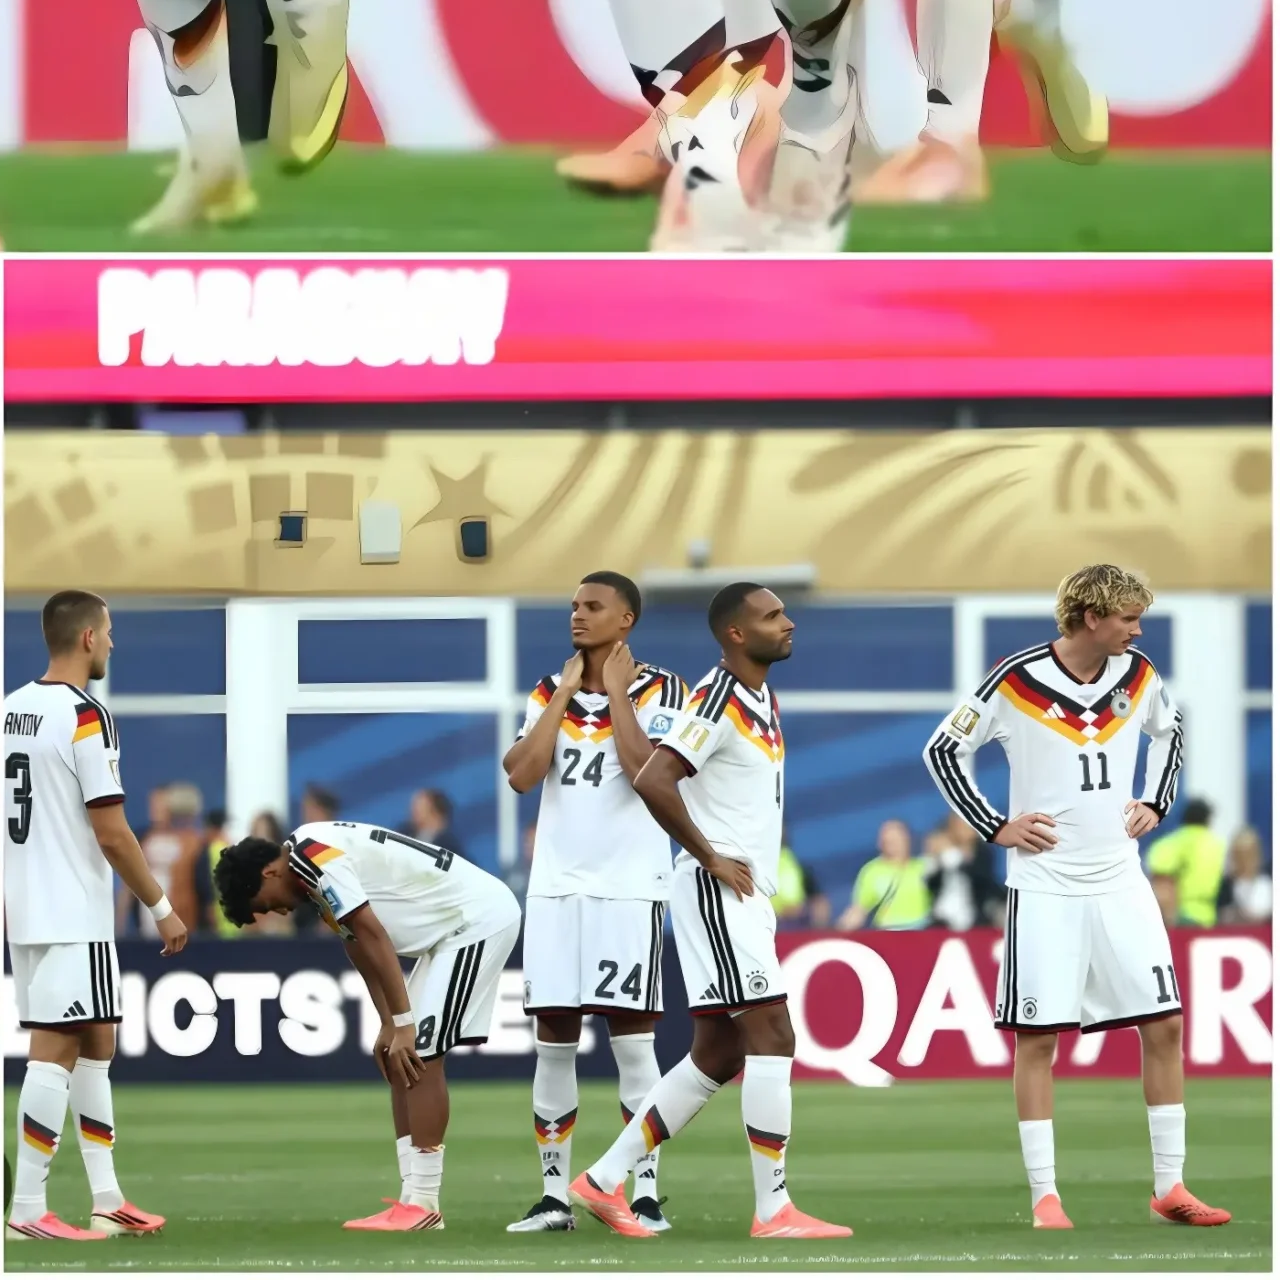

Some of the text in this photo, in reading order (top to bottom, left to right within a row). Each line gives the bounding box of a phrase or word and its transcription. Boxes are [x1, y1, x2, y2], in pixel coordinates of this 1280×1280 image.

[560, 748, 606, 788] 24
[1079, 751, 1112, 792] 11
[5, 752, 33, 845] 3
[594, 959, 643, 1002] 24
[776, 938, 1272, 1087] QAR
